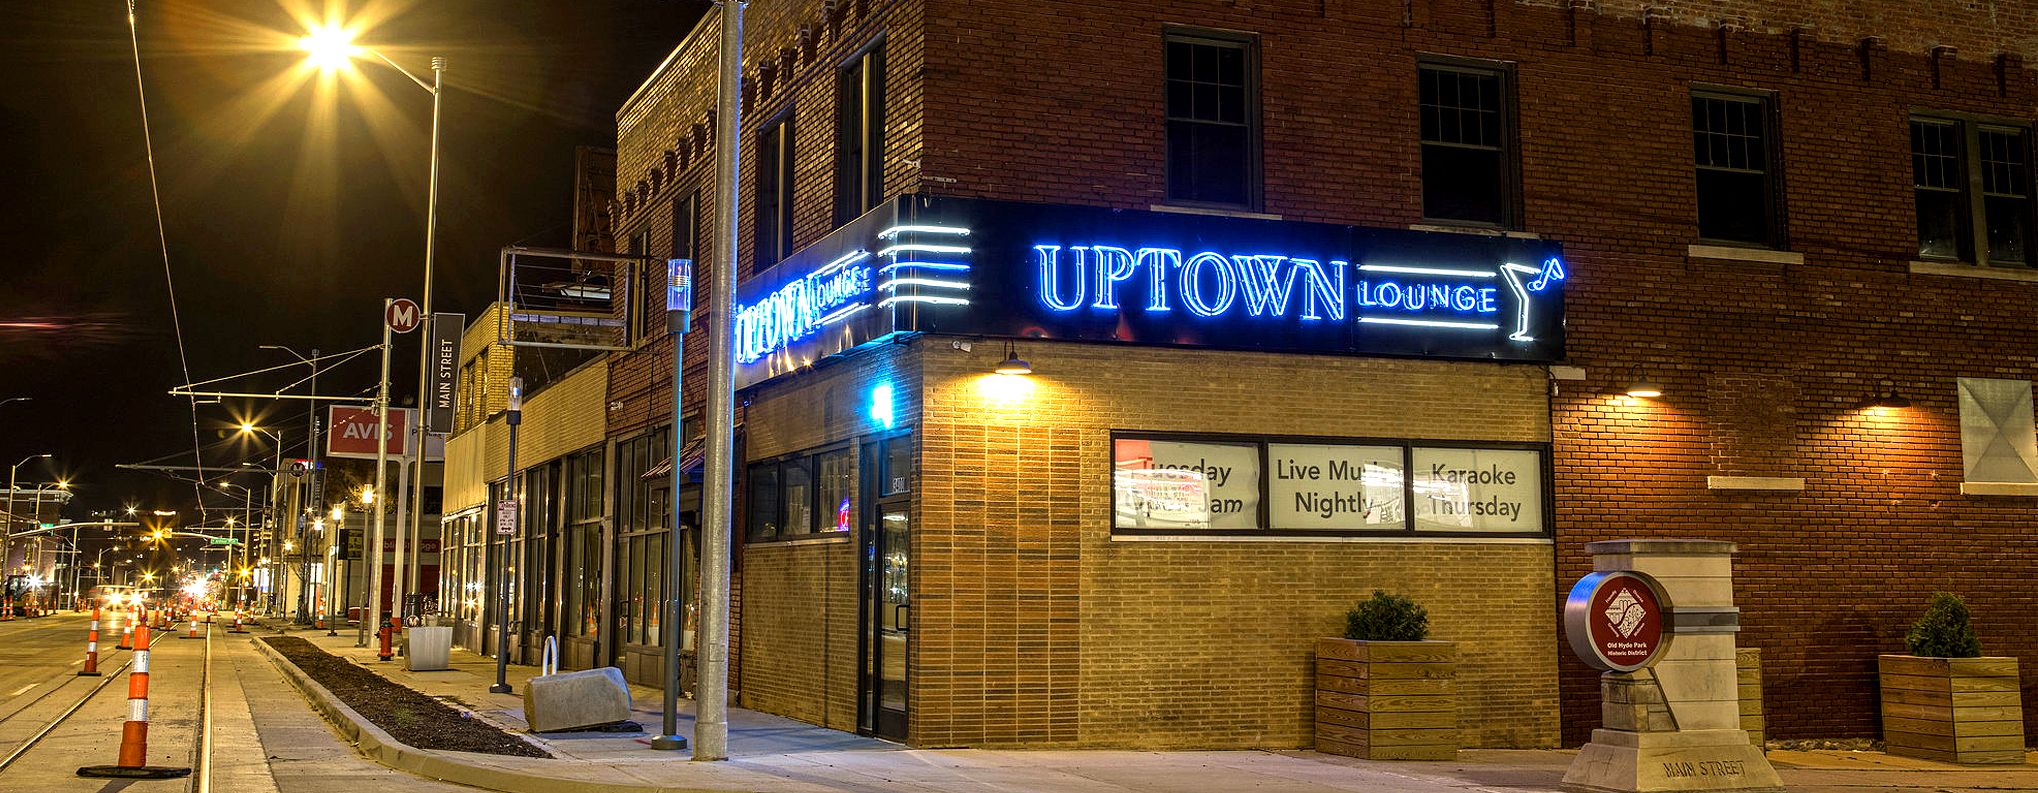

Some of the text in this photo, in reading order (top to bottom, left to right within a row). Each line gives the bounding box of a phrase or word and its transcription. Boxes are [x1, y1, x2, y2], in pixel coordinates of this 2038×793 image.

[811, 264, 866, 314] LOUNGE
[1034, 244, 1498, 321] UPTOWN LOUNGE
[392, 304, 413, 327] M
[438, 339, 453, 408] MAIN STREET
[342, 422, 394, 440] AVIS
[1277, 459, 1321, 481] Live
[1432, 463, 1516, 485] Karaoke
[1198, 492, 1243, 514] Jam
[1295, 491, 1374, 520] Nightly
[1427, 495, 1522, 522] Thursday
[1618, 642, 1632, 650] Hyde
[1662, 760, 1746, 778] MAIN STREET
